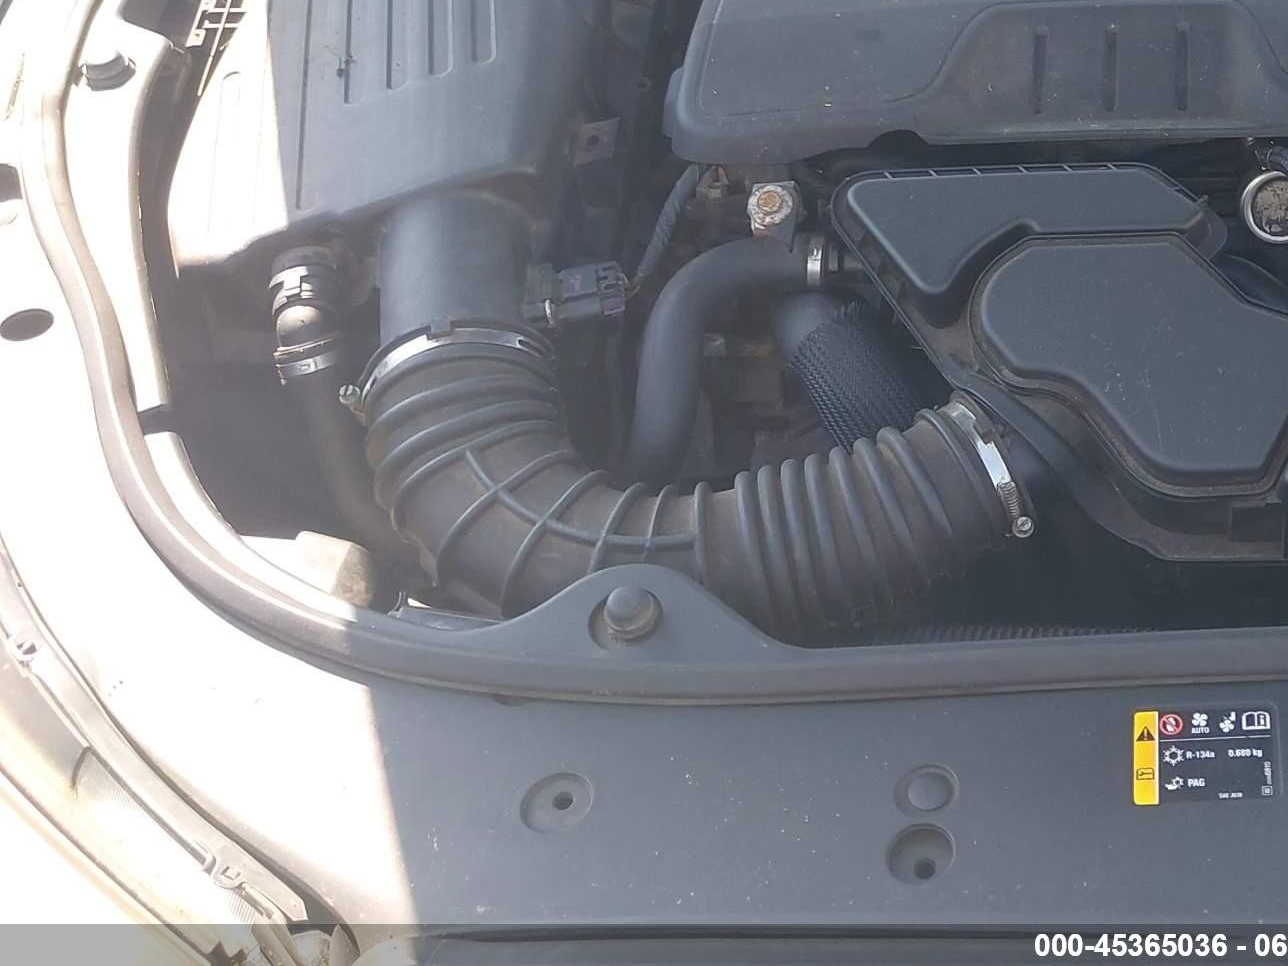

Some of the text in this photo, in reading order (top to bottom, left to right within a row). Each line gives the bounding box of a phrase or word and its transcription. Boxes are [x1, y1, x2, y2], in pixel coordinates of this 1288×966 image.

[1191, 726, 1210, 734] AUTO
[1186, 750, 1216, 759] R-134a
[1252, 747, 1263, 758] kg
[1187, 778, 1206, 787] PAG
